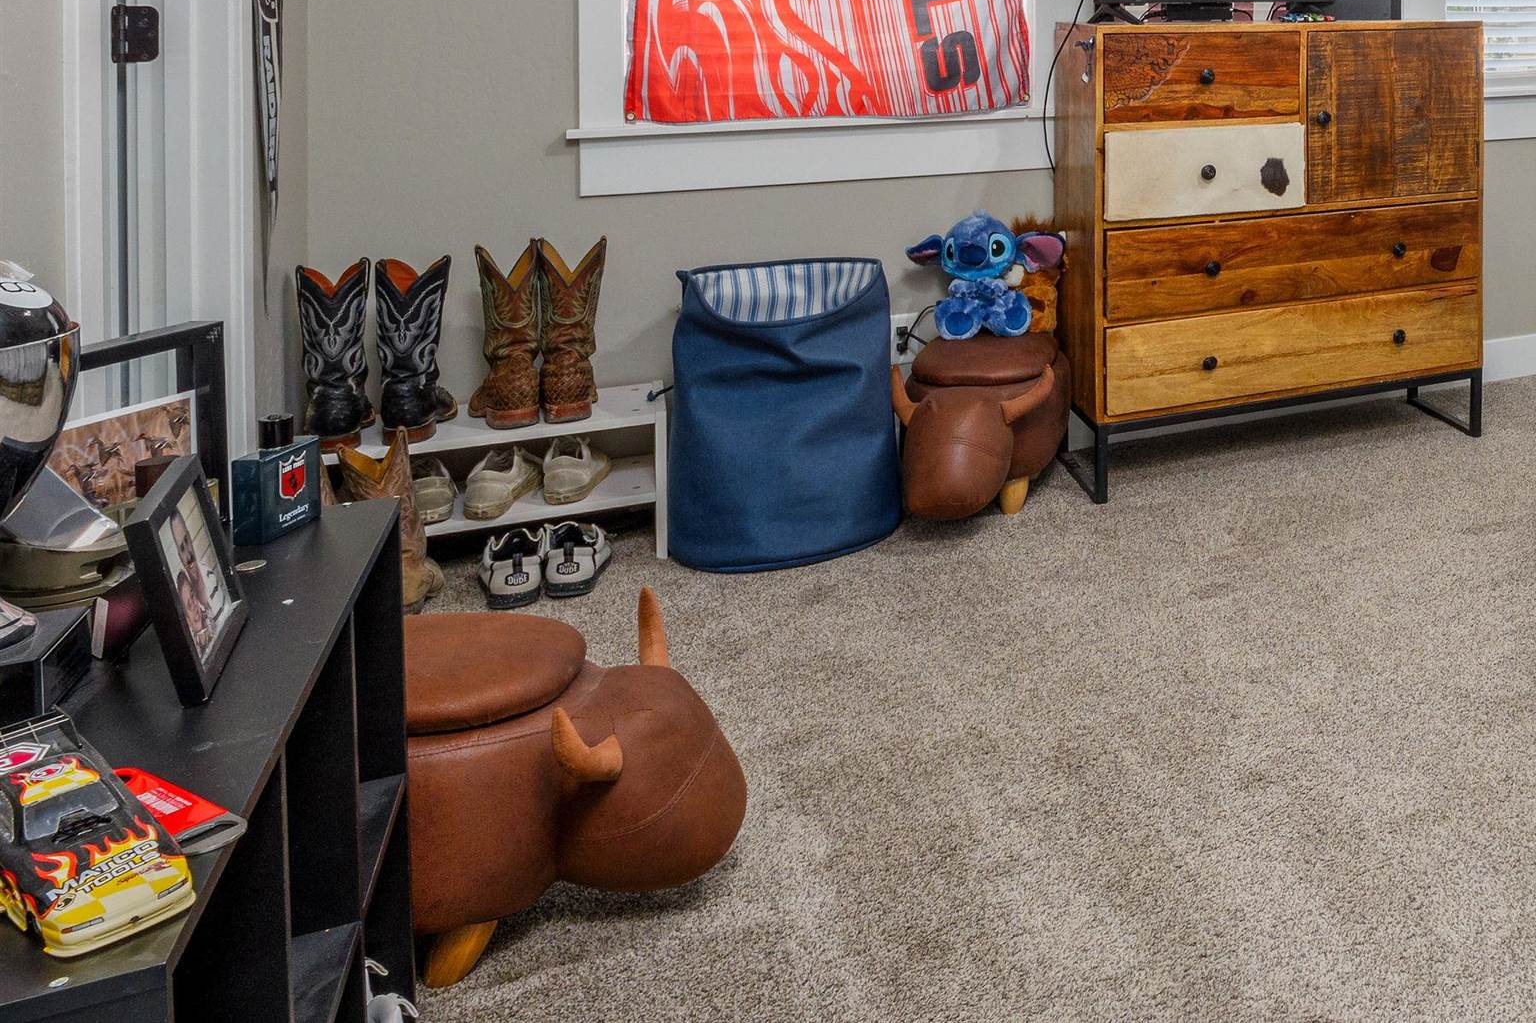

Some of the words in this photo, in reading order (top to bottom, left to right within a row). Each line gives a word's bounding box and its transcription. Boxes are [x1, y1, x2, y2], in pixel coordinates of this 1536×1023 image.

[279, 503, 309, 523] Legendary
[559, 564, 578, 574] DUDE
[507, 575, 528, 585] DUDE
[46, 840, 160, 902] MATCO
[75, 851, 161, 894] TOOLS
